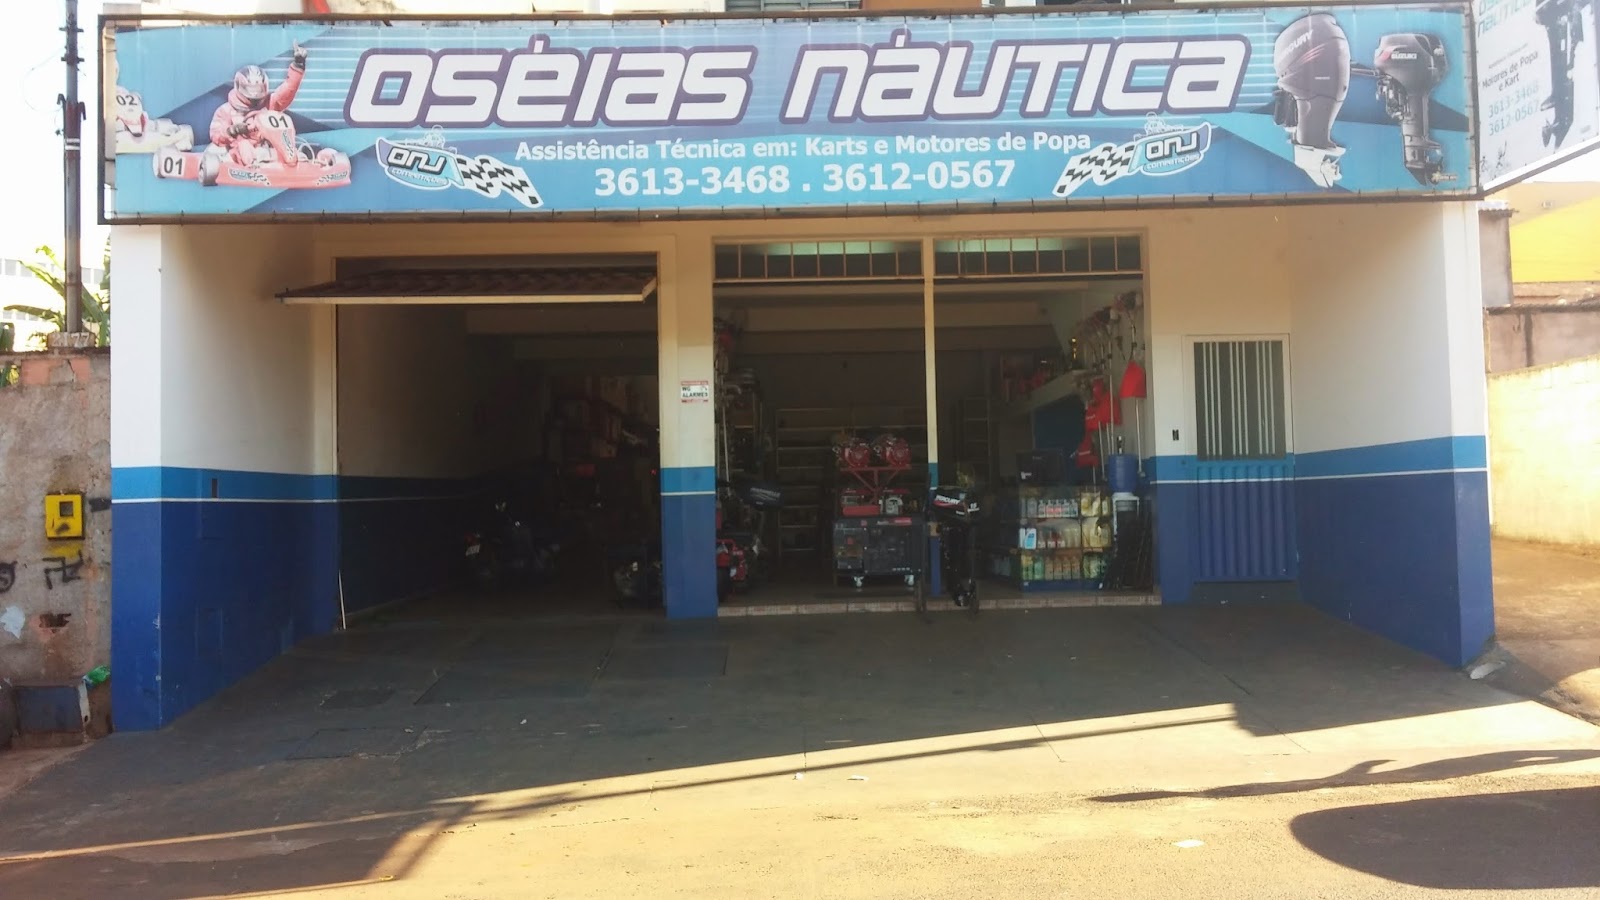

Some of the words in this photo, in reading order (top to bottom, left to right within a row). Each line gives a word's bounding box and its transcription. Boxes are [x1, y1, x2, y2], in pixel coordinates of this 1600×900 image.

[1504, 72, 1520, 88] Kart
[116, 95, 138, 106] 02
[268, 115, 289, 129] 01
[515, 140, 649, 162] Assistência
[656, 137, 746, 160] Técnica
[753, 139, 797, 158] em:
[806, 136, 869, 157] Karts
[874, 140, 889, 155] e
[896, 133, 989, 155] Motores
[1001, 131, 1030, 152] de
[1034, 130, 1092, 157] Popa
[163, 156, 184, 176] 01
[594, 165, 791, 197] 3613-3468
[823, 159, 1016, 193] 3612-0567
